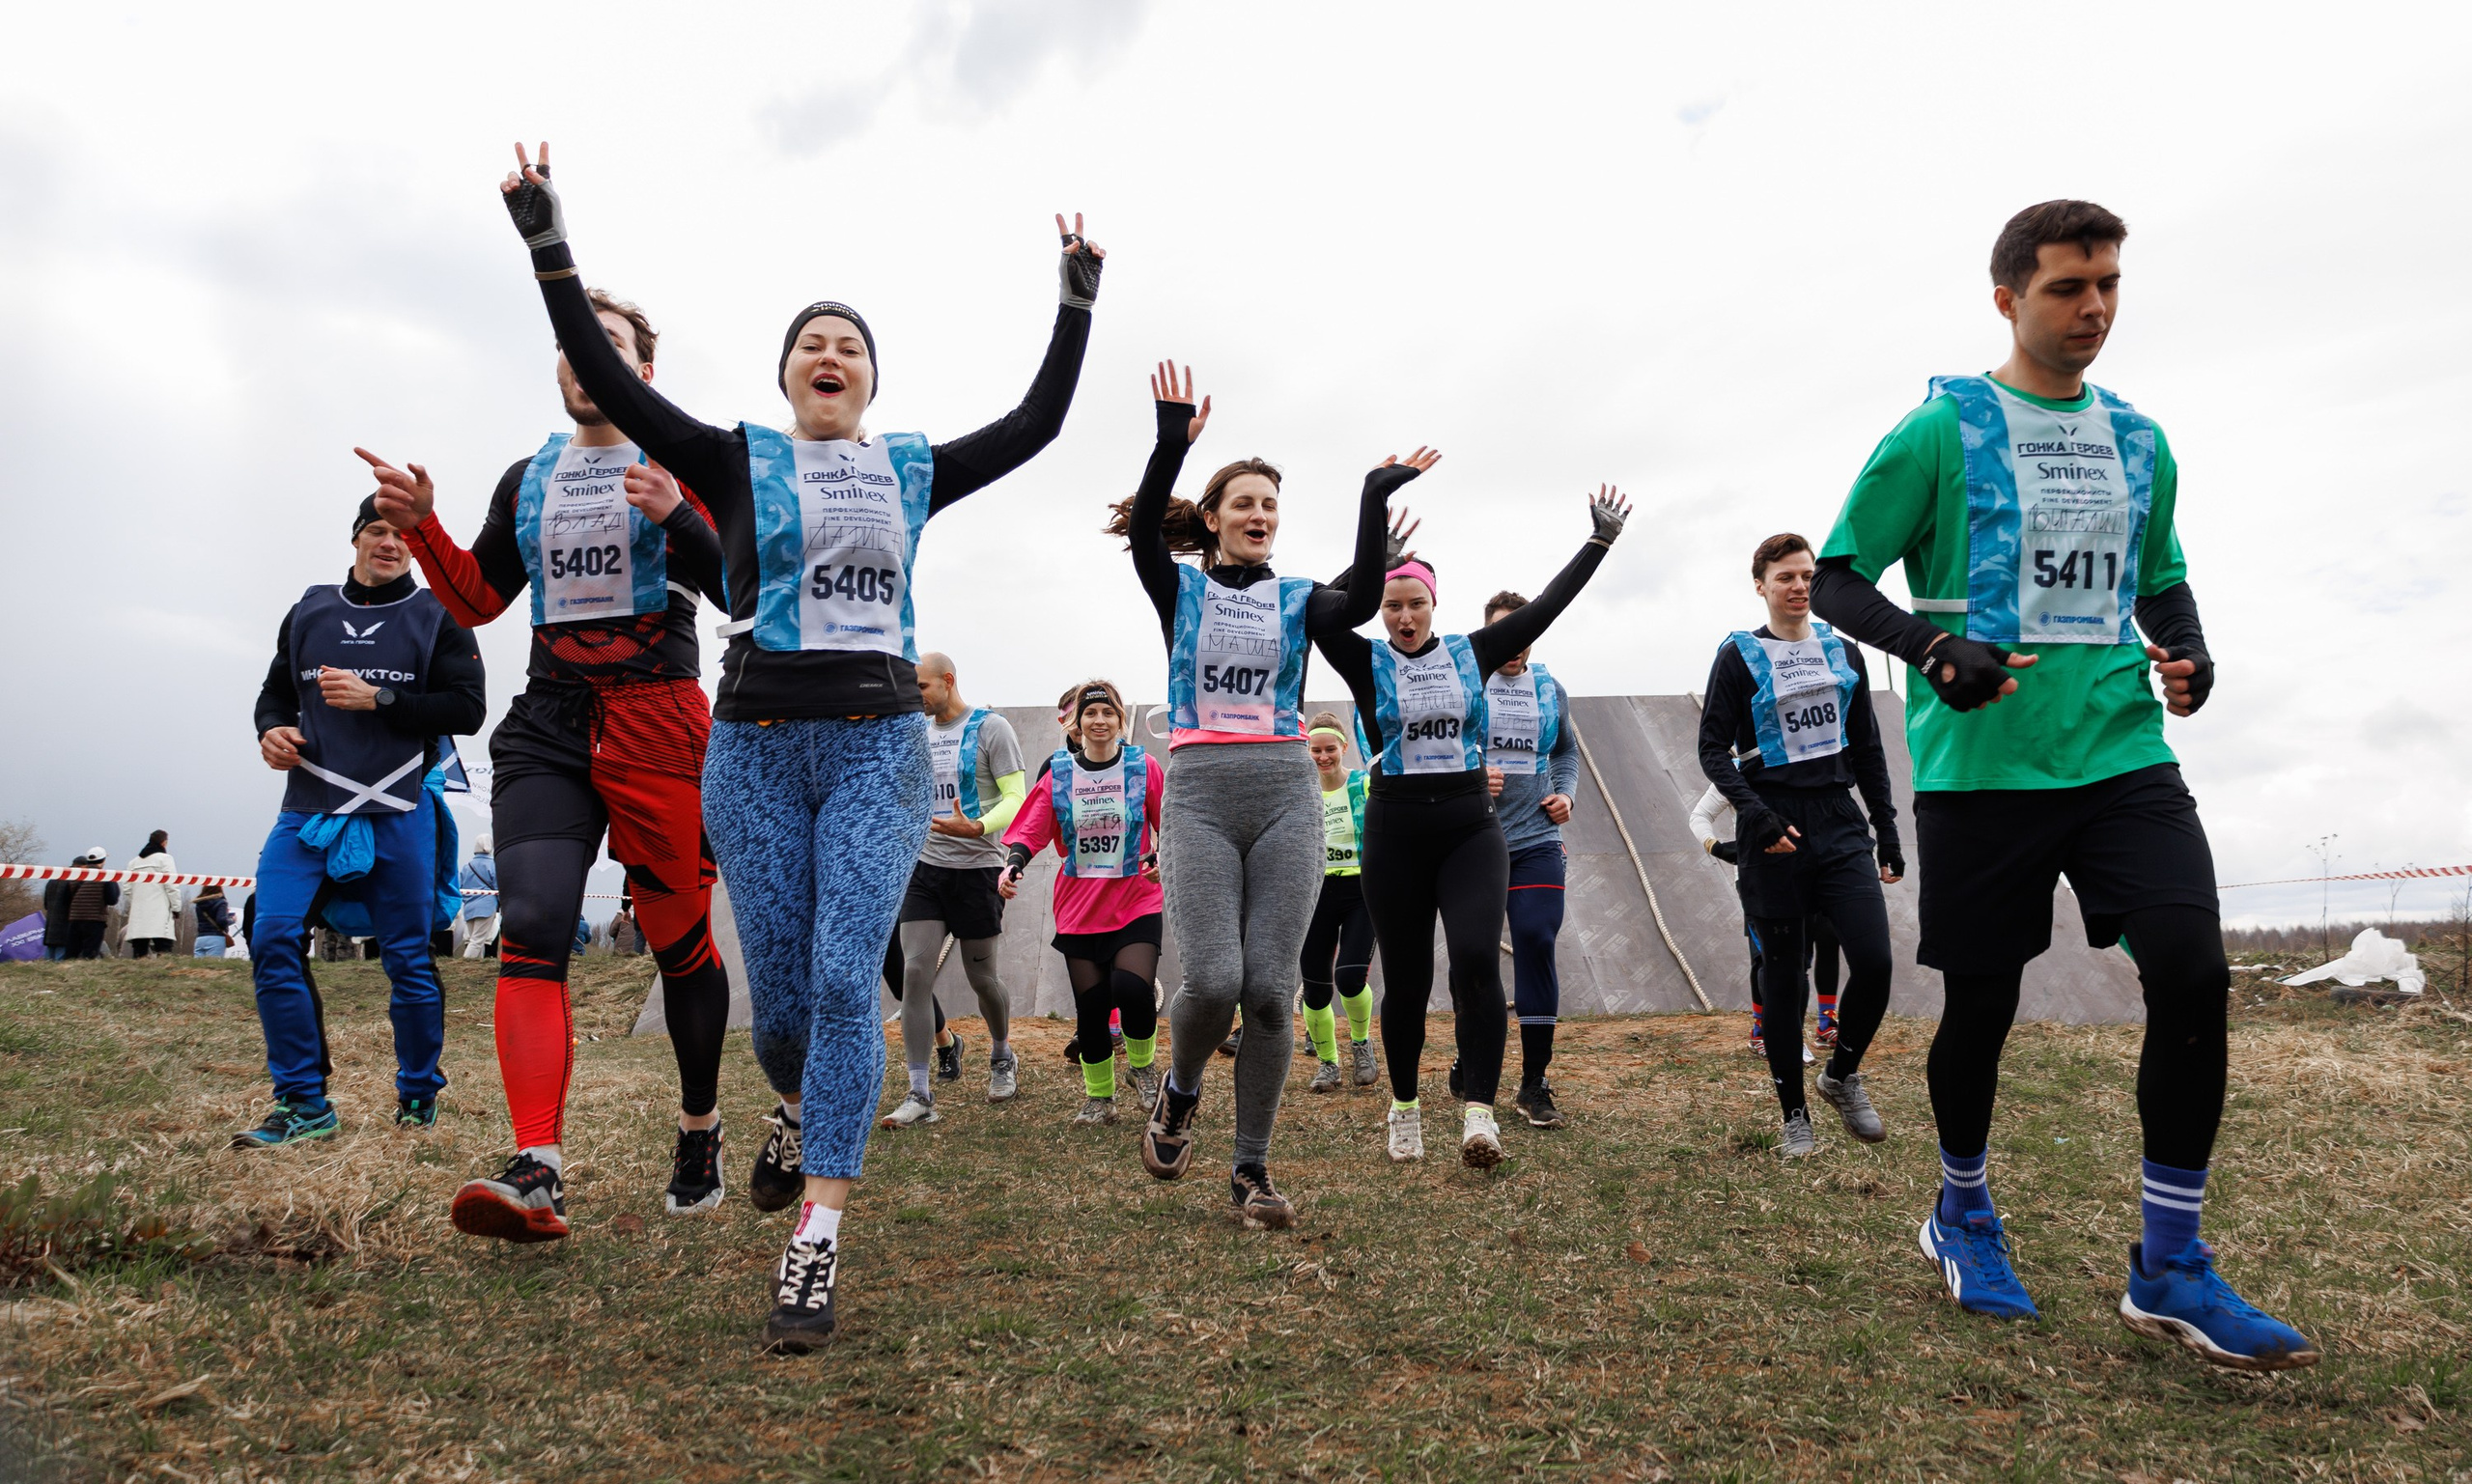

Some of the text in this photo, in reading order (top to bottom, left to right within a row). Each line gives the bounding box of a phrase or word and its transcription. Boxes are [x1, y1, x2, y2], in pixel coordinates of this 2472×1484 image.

[2017, 441, 2114, 456] ГОНКА ГЕРОЕВ
[555, 468, 587, 479] ГОНКА
[803, 468, 848, 480] ГОНКА
[2037, 462, 2108, 481] Sminex
[562, 484, 615, 498] Sminex
[820, 484, 888, 503] Sminex
[823, 507, 891, 518] ПЕРФЕКЦИОНИСТЫ
[548, 512, 622, 539] ВЛАД
[844, 516, 892, 526] DEVELOPMENT
[550, 545, 623, 579] 5402
[2034, 549, 2118, 591] 5411
[811, 564, 897, 605] 5405
[1241, 595, 1276, 608] ГЕРОЕВ
[1215, 603, 1265, 623] Sminex
[1203, 664, 1270, 696] 5407
[1407, 672, 1447, 685] Sminex
[1781, 668, 1820, 682] Sminex
[1498, 697, 1529, 708] Sminex
[1221, 713, 1260, 721] ГАЗПРОМБАНК
[1784, 702, 1837, 734] 5408
[1406, 717, 1460, 742] 5403
[1493, 736, 1533, 752] 5406
[1082, 797, 1114, 806] Sminex
[1079, 835, 1120, 854] 5397
[1327, 847, 1353, 862] 390
